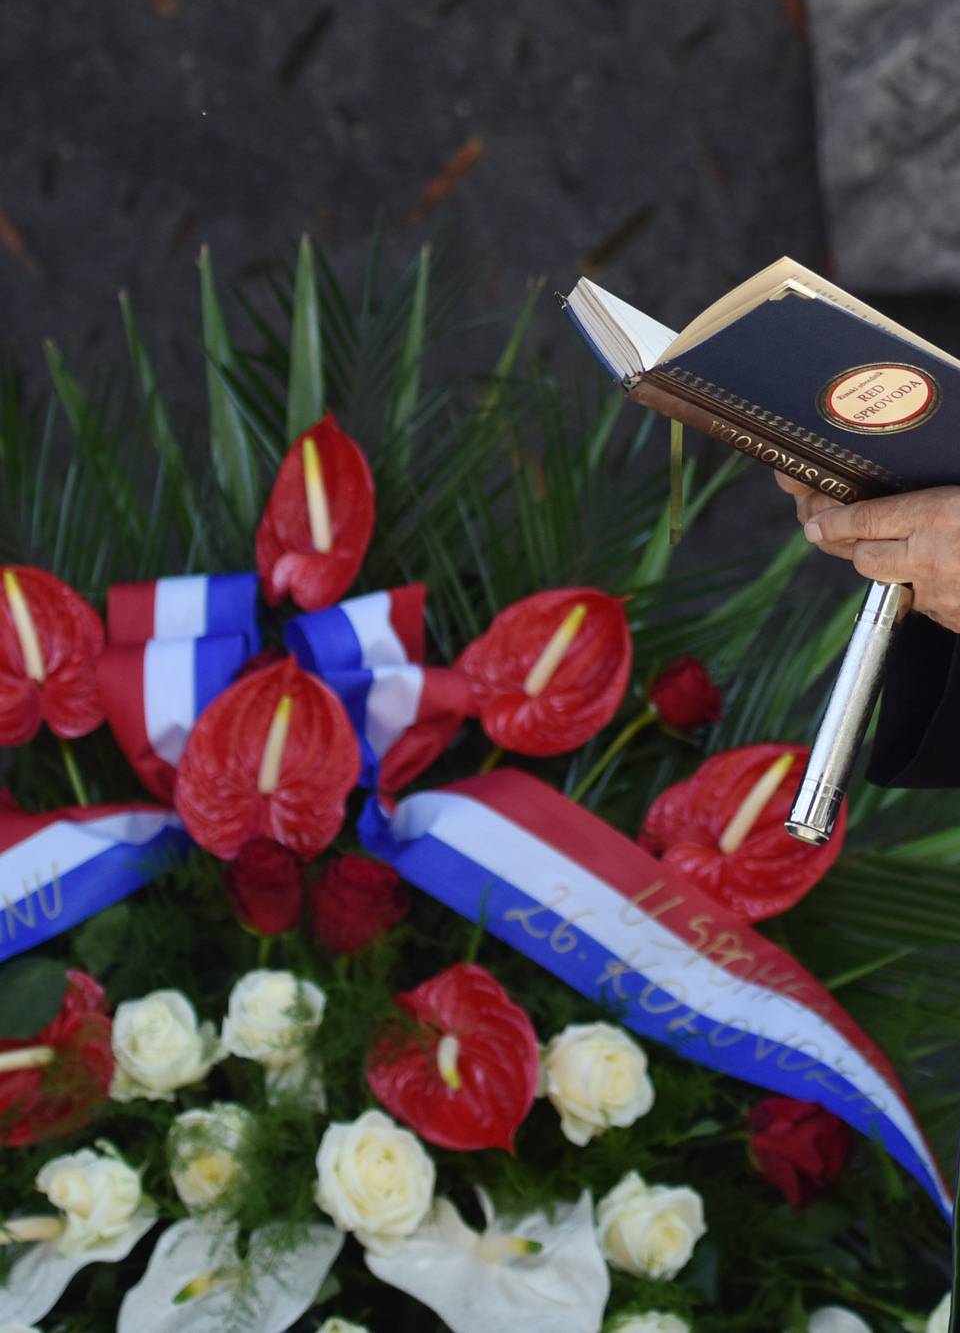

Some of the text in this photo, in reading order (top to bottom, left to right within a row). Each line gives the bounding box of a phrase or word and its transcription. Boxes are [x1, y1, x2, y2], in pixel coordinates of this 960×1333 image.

[853, 380, 923, 422] SPROVODA
[857, 384, 885, 402] RED
[709, 420, 819, 482] SPROVODA
[501, 883, 597, 962] 26.
[618, 878, 688, 928] U
